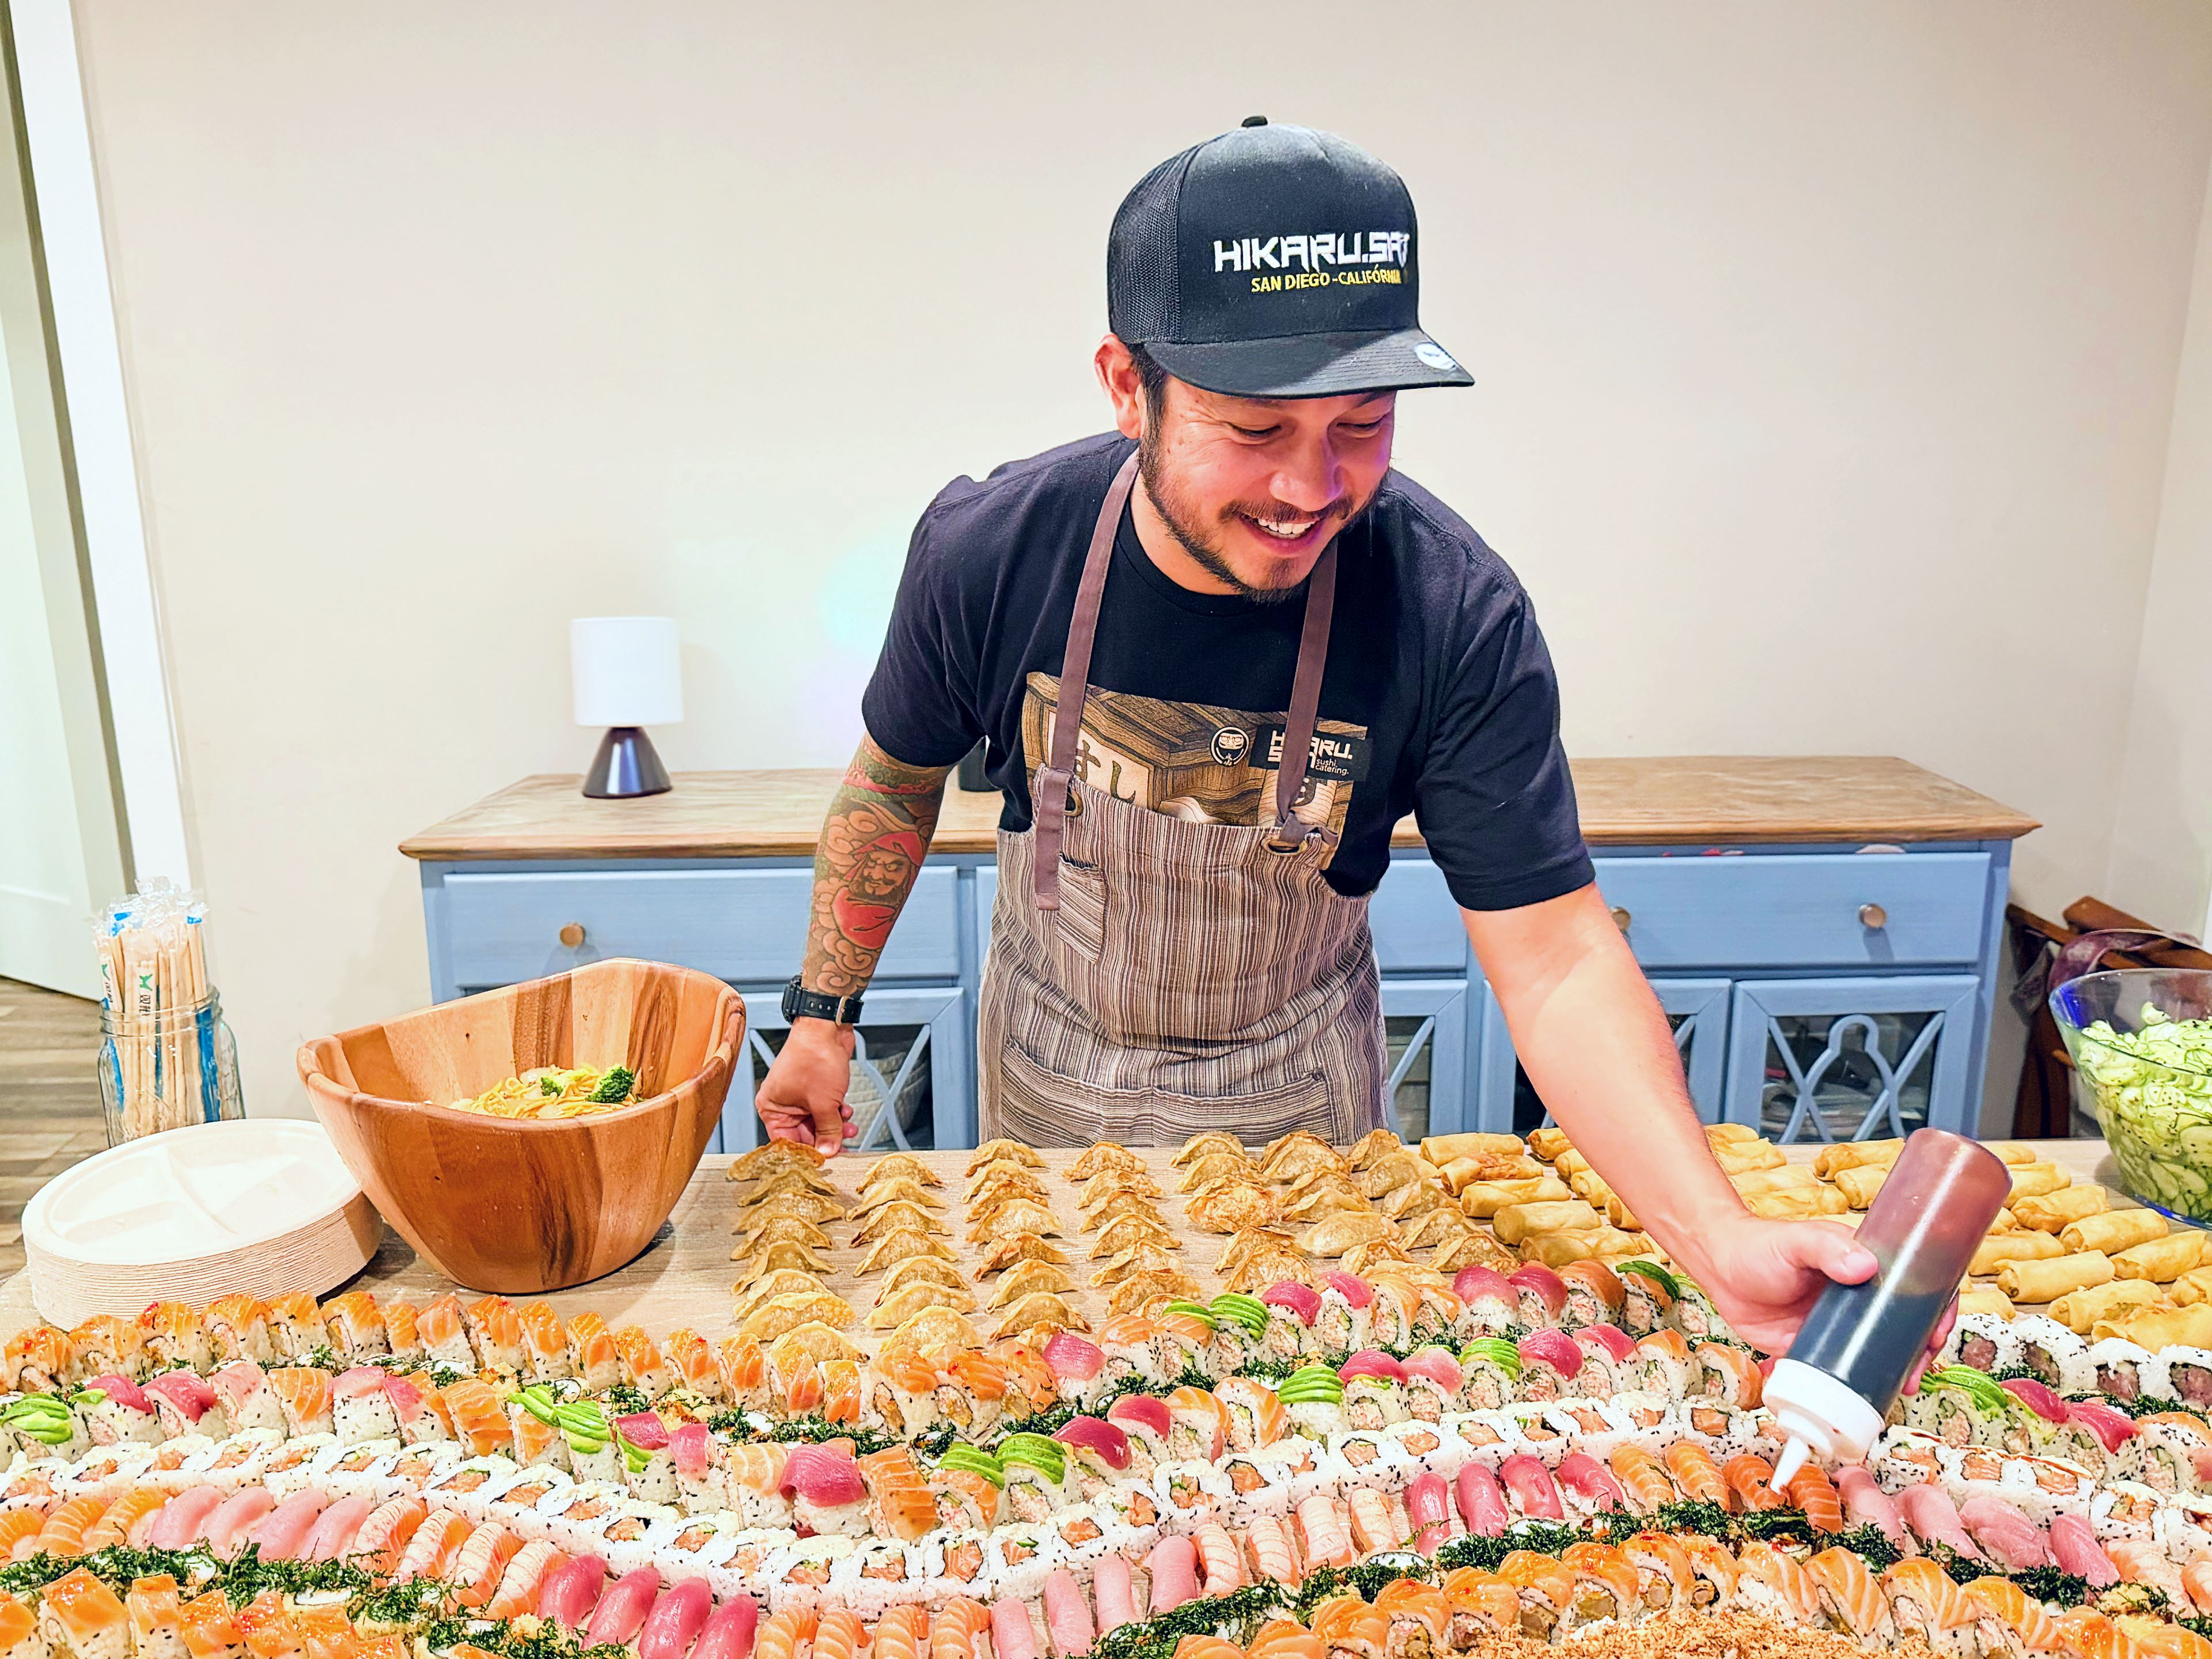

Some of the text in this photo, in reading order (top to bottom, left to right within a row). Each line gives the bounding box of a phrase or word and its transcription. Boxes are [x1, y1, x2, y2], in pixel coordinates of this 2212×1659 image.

[1251, 275, 1282, 293] SAN
[1284, 272, 1331, 290] DIEGO
[1316, 758, 1337, 767] sushi
